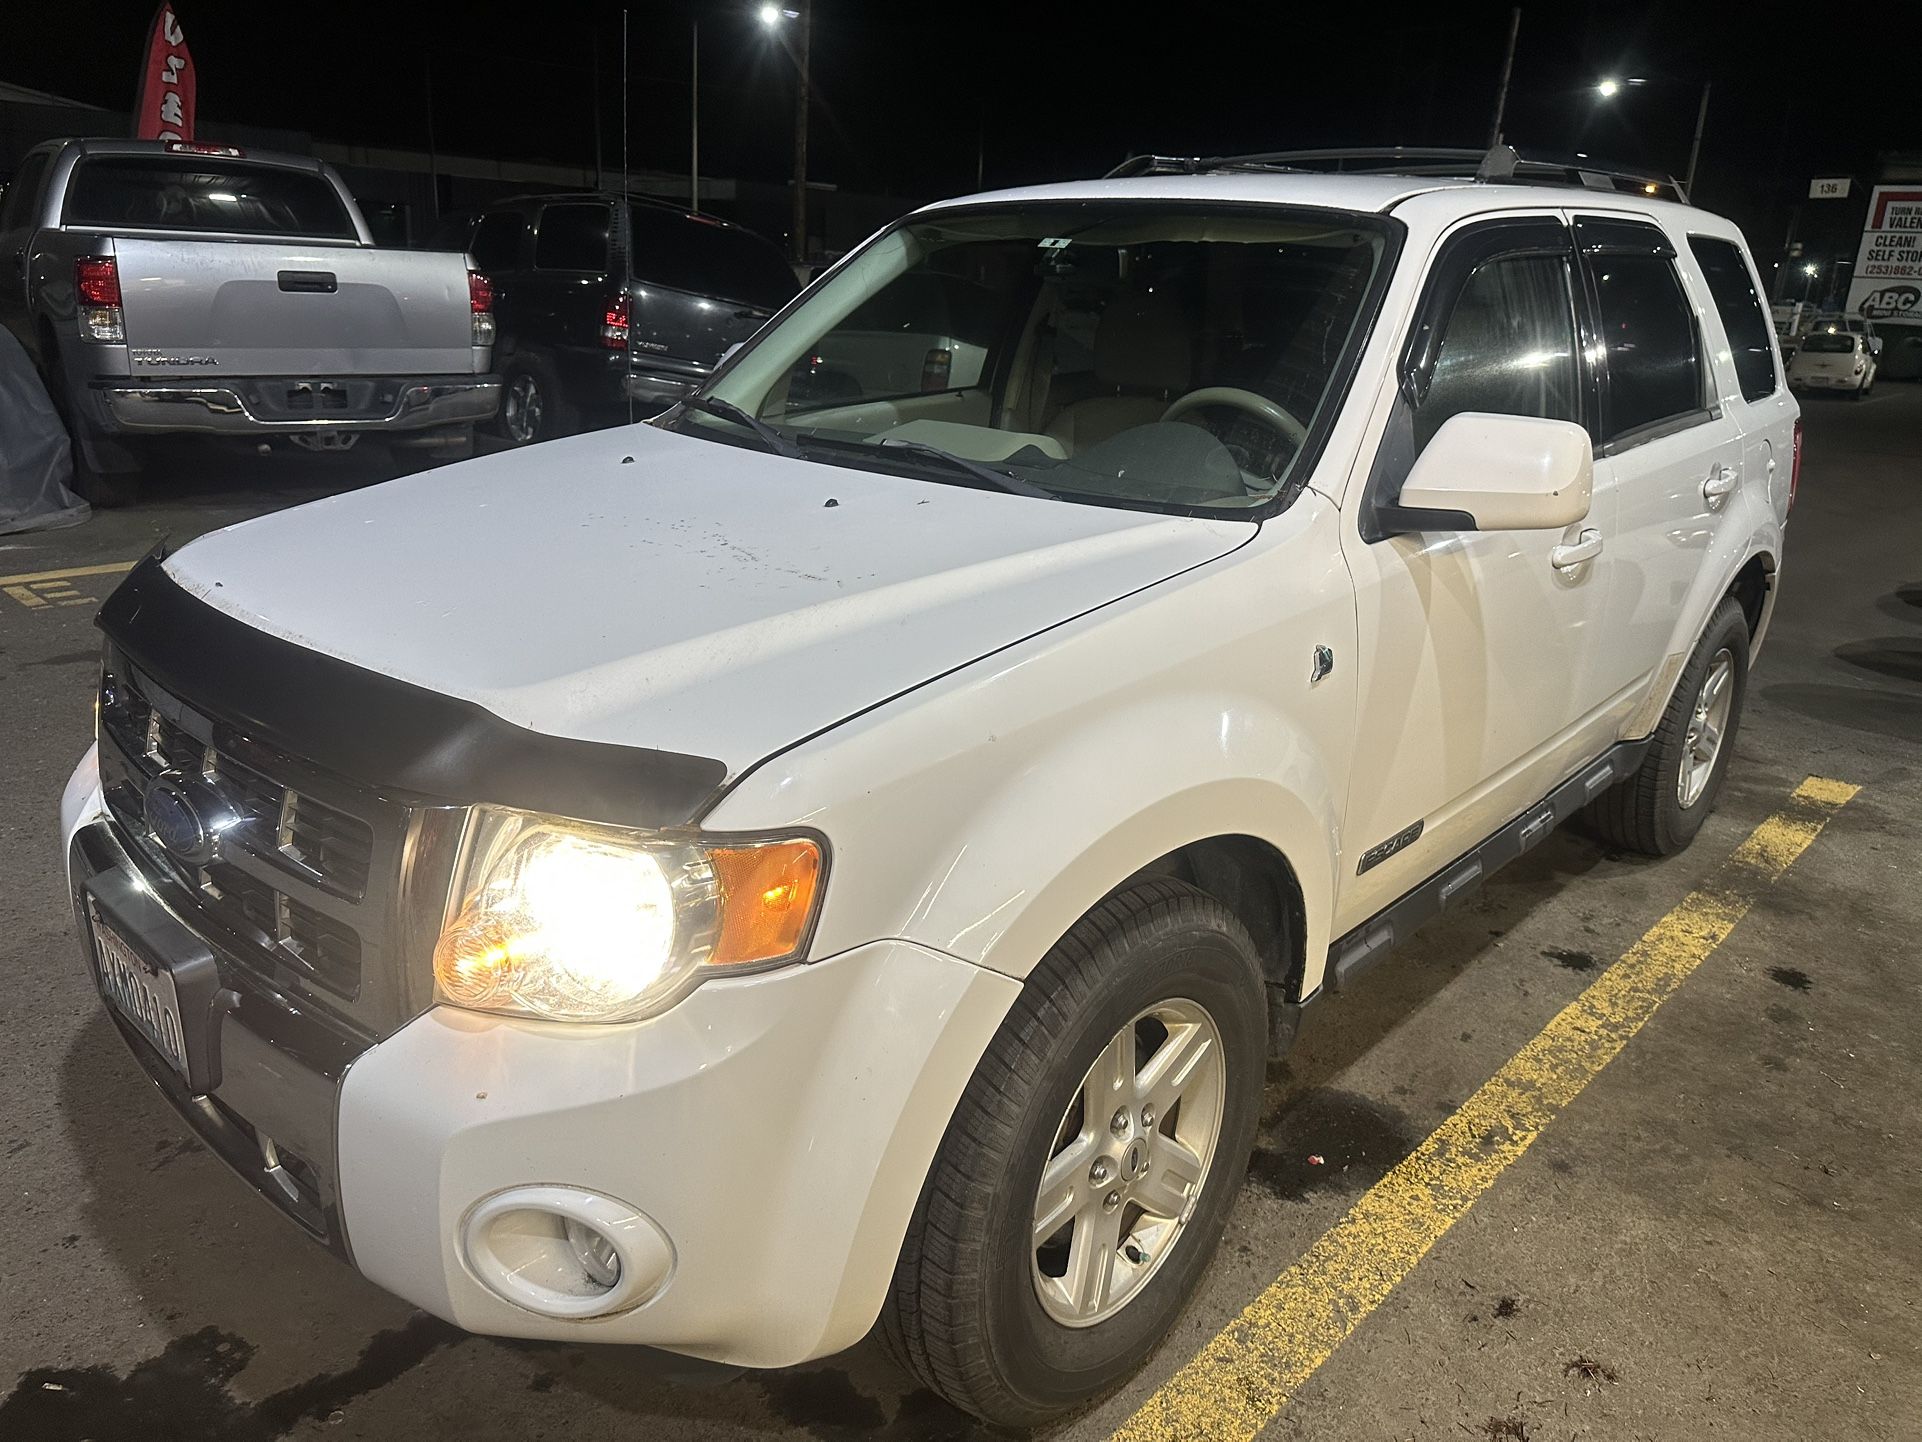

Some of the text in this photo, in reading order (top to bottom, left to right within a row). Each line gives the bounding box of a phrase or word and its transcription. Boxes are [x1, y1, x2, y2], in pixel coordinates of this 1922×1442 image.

[160, 11, 185, 140] USE
[1820, 183, 1838, 194] 136
[1891, 206, 1912, 216] TURN
[1875, 235, 1916, 248] CLEAN!
[1867, 249, 1895, 261] SELF
[1864, 292, 1915, 311] ABC
[133, 357, 219, 366] TUNDRA
